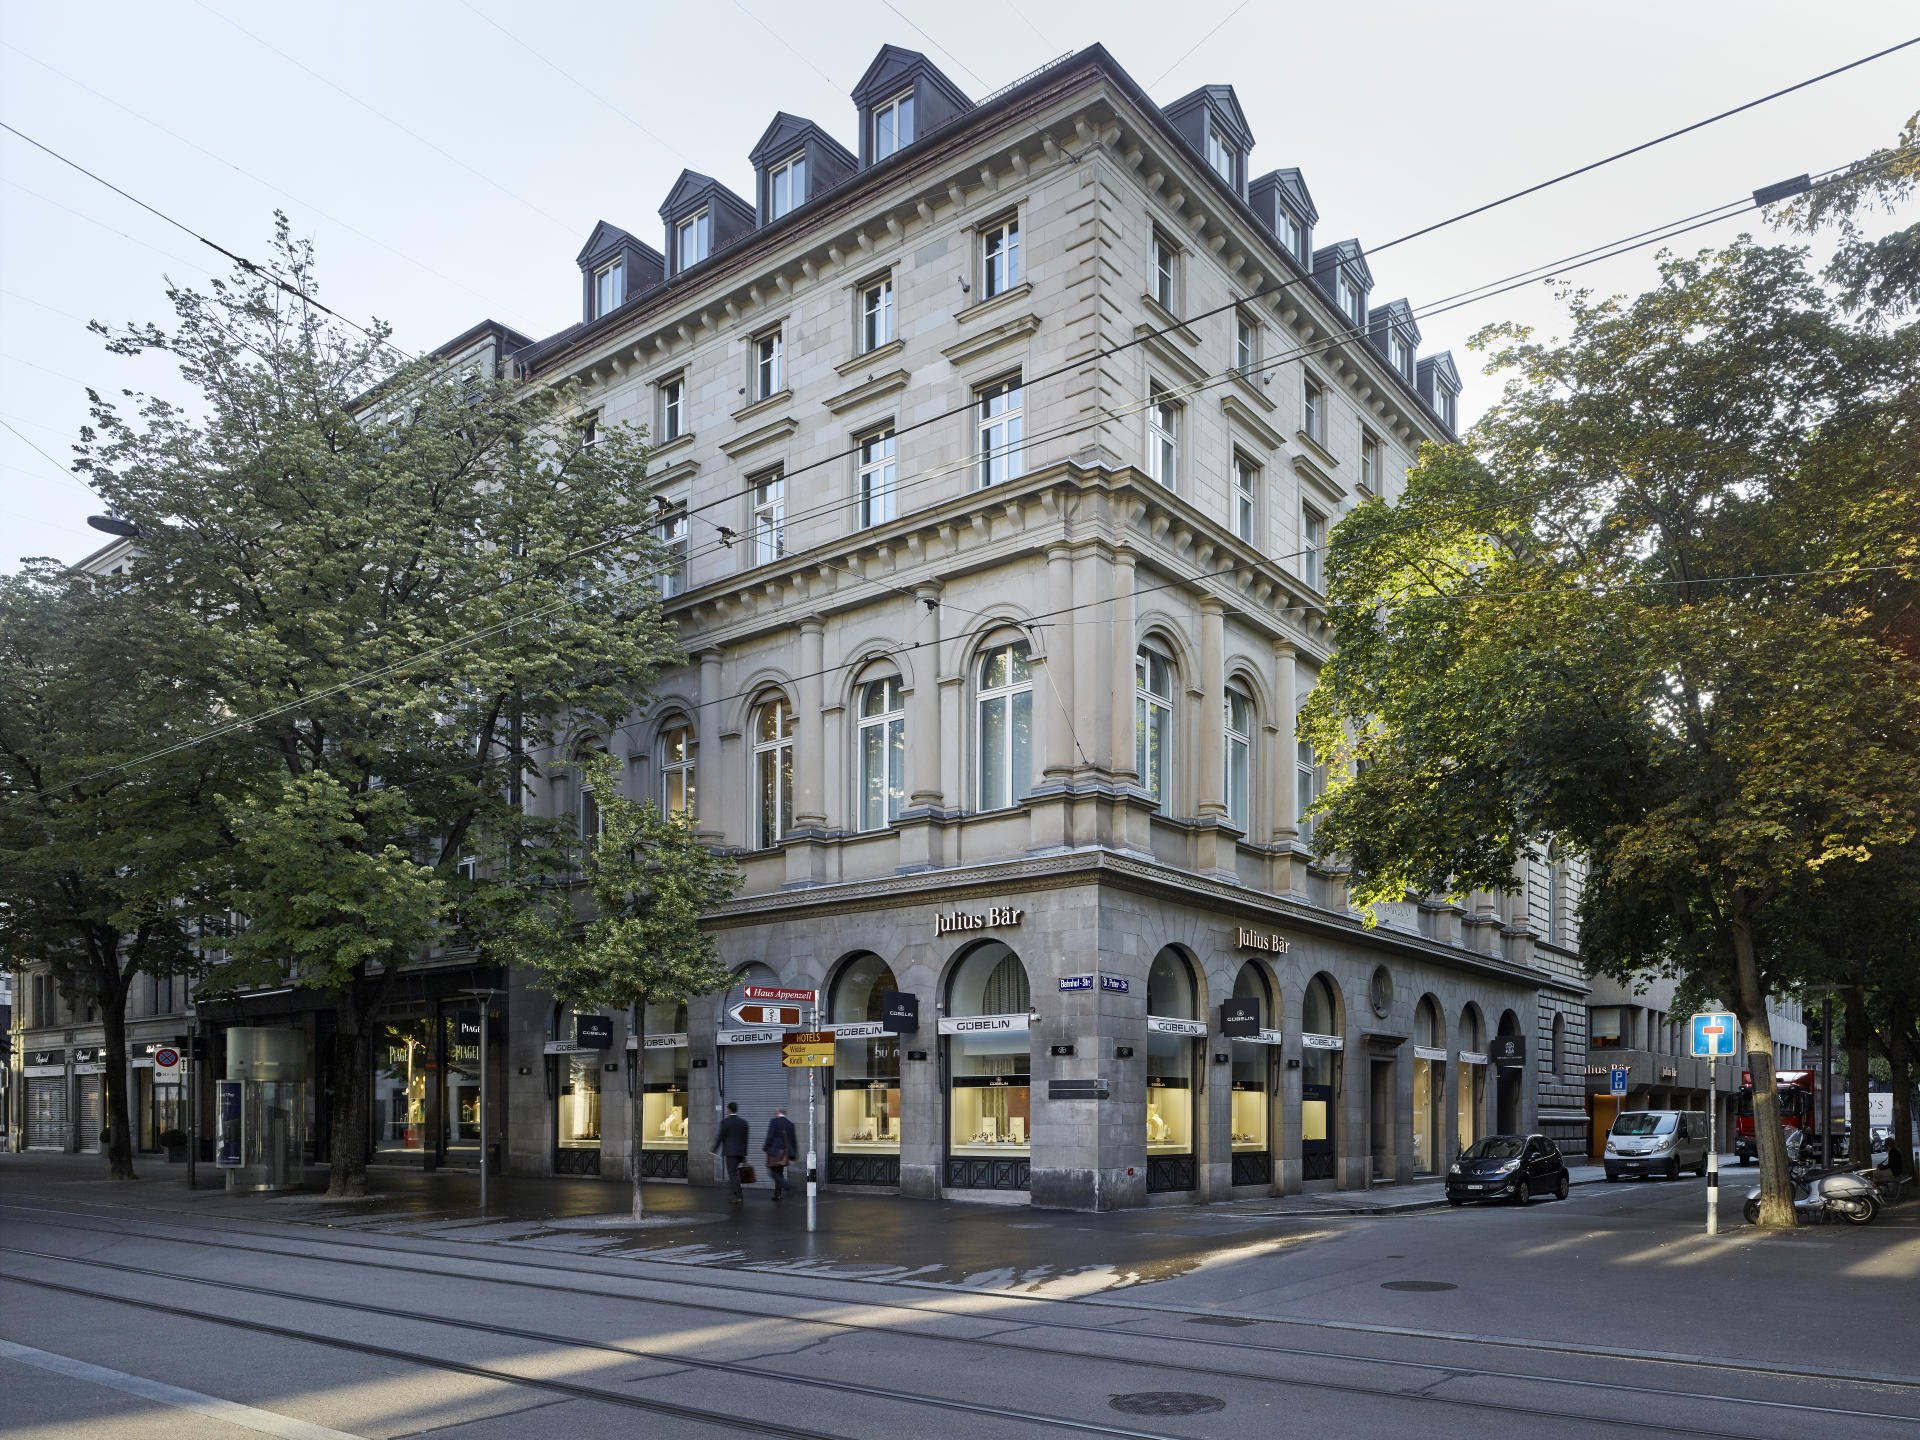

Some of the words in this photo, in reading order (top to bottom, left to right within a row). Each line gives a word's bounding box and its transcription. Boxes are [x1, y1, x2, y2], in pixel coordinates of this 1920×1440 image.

[935, 912, 982, 937] Julius
[989, 906, 1021, 926] Bär
[1239, 926, 1269, 950] Julius
[1272, 934, 1290, 953] Bär
[754, 988, 774, 998] Haus
[775, 989, 812, 1000] Appenzell
[956, 1019, 1010, 1031] GÜBELIN
[1158, 1022, 1198, 1034] GÜBELIN
[731, 1033, 773, 1042] GÜBELIN
[796, 1033, 821, 1042] HOTELS
[836, 1026, 882, 1037] GÜBELIN
[643, 1037, 677, 1047] ÜBELIN
[1309, 1037, 1337, 1047] GÜBELIN
[389, 1045, 408, 1064] PIAGE
